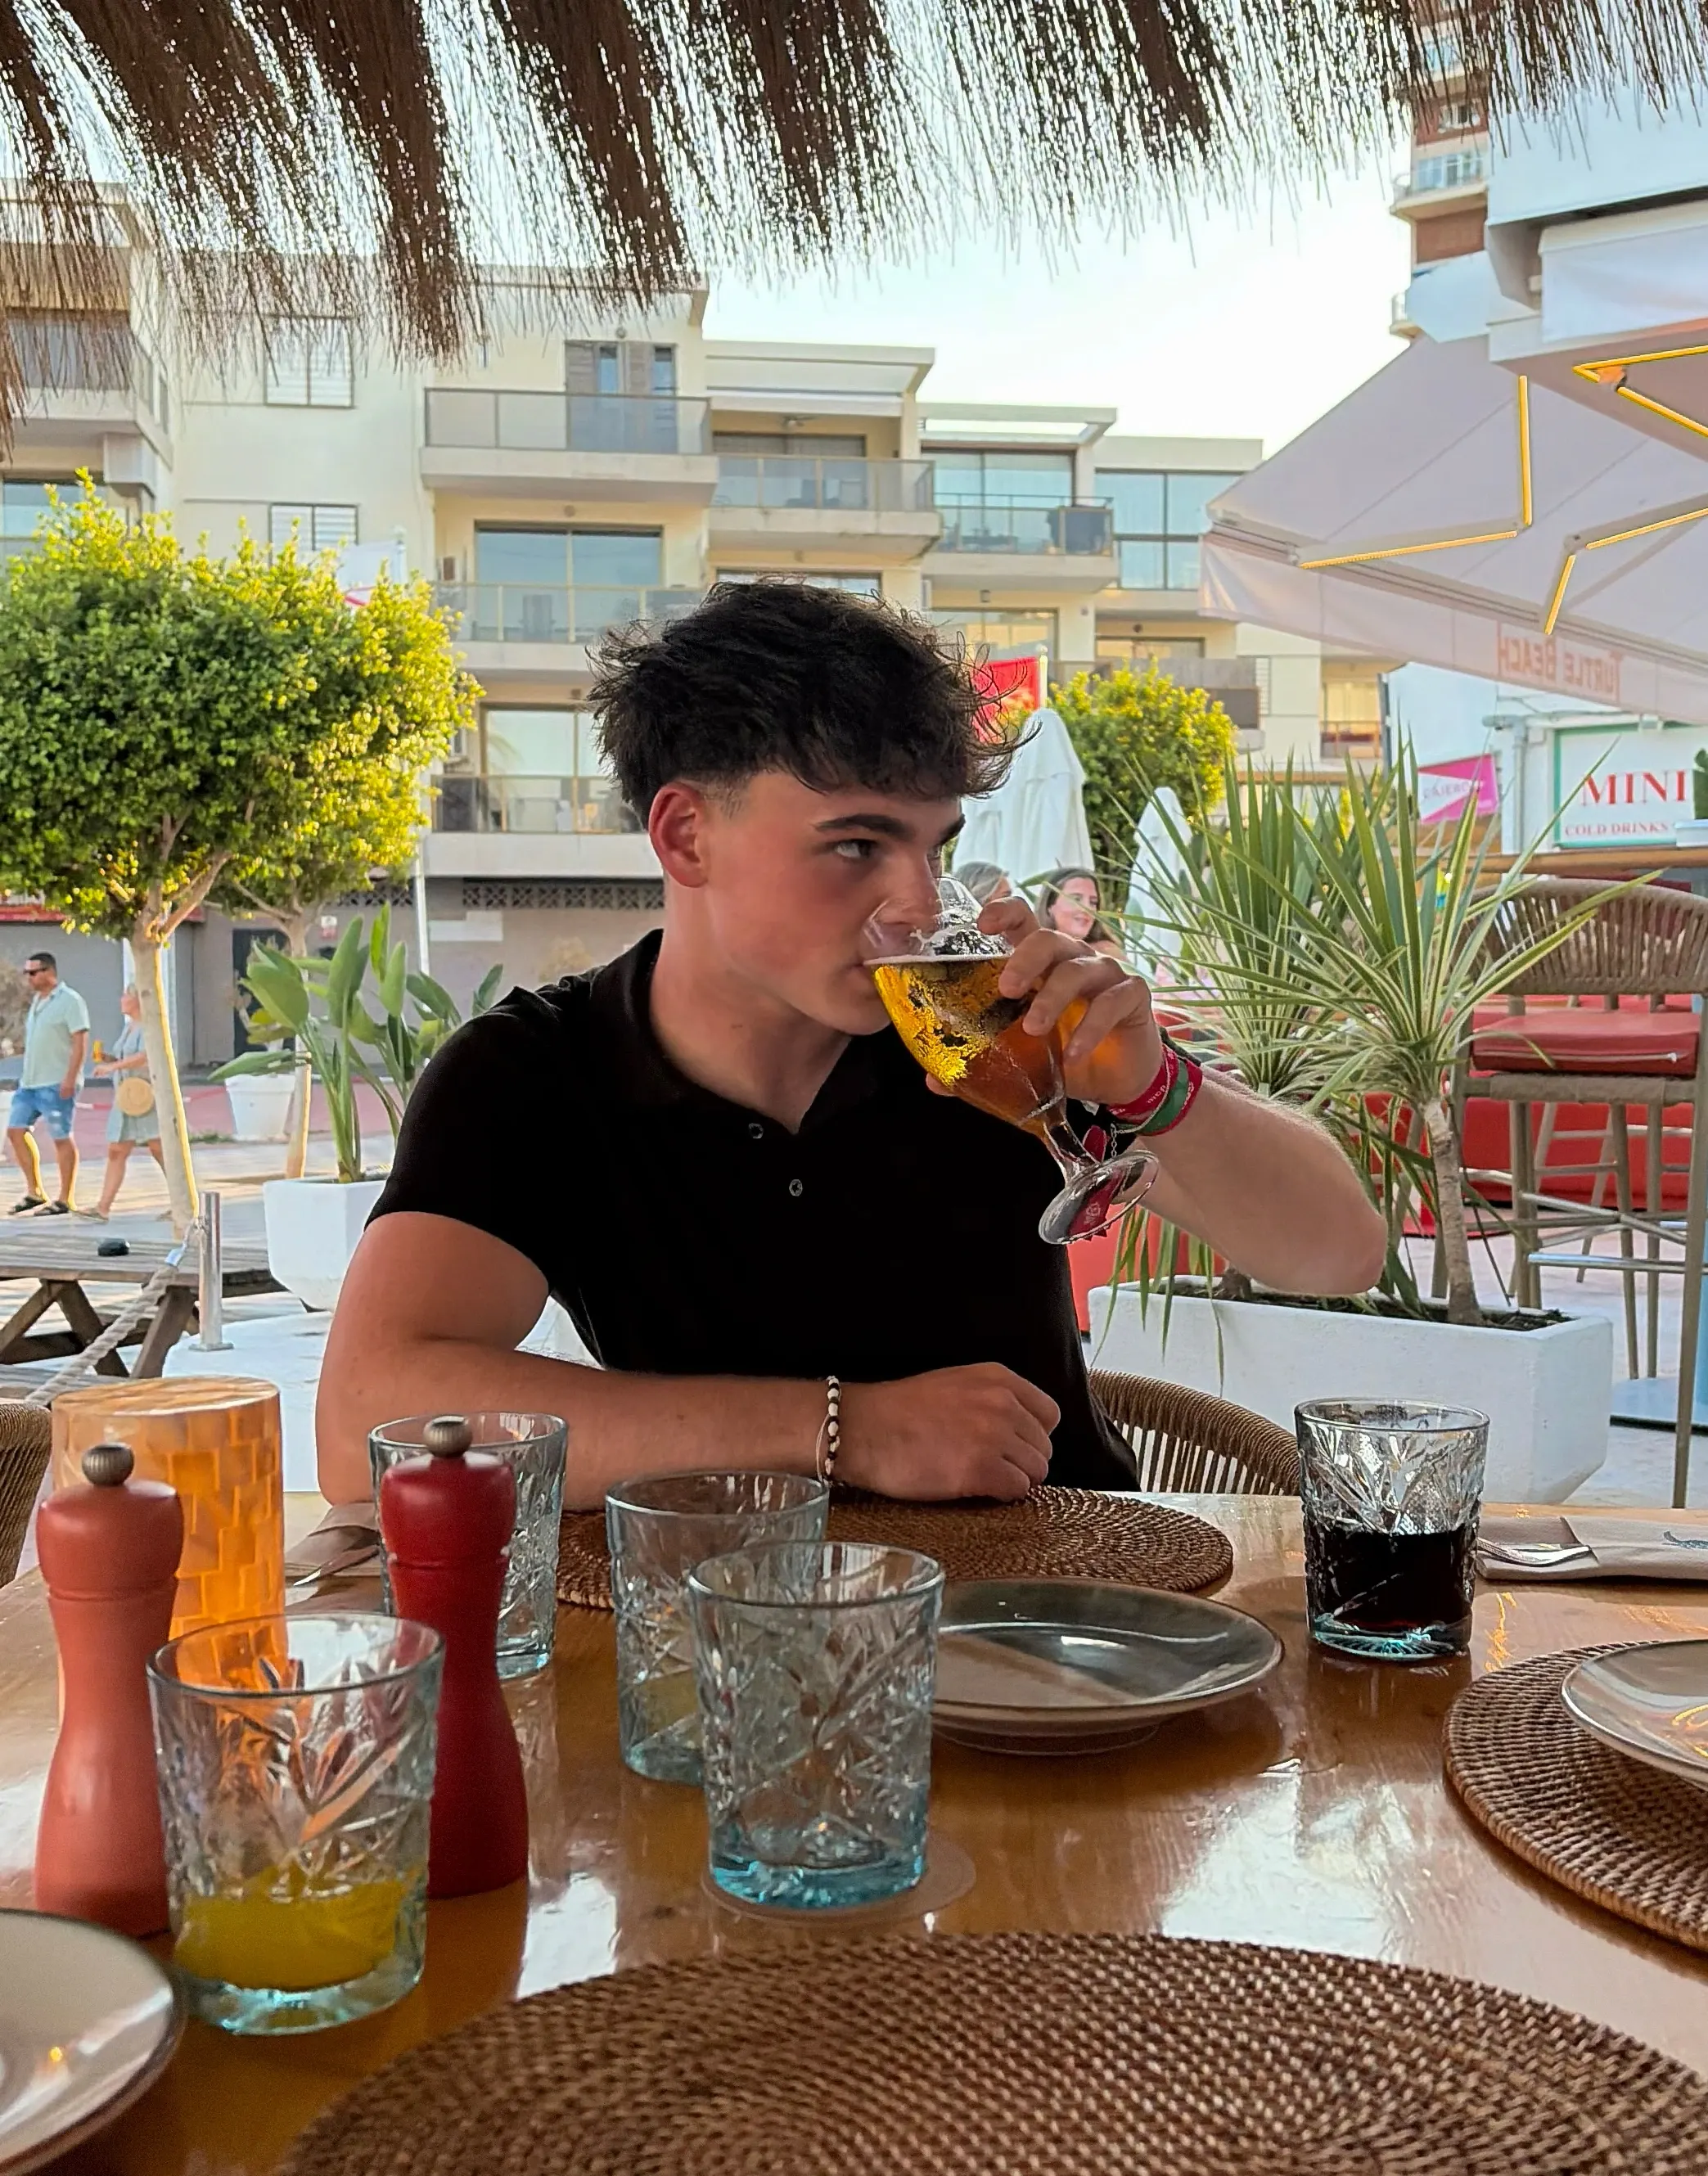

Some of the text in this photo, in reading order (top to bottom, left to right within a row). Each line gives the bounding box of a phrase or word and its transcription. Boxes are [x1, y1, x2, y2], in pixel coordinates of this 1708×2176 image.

[1581, 769, 1688, 807] MINI
[1565, 822, 1669, 836] COLD DRINKS
